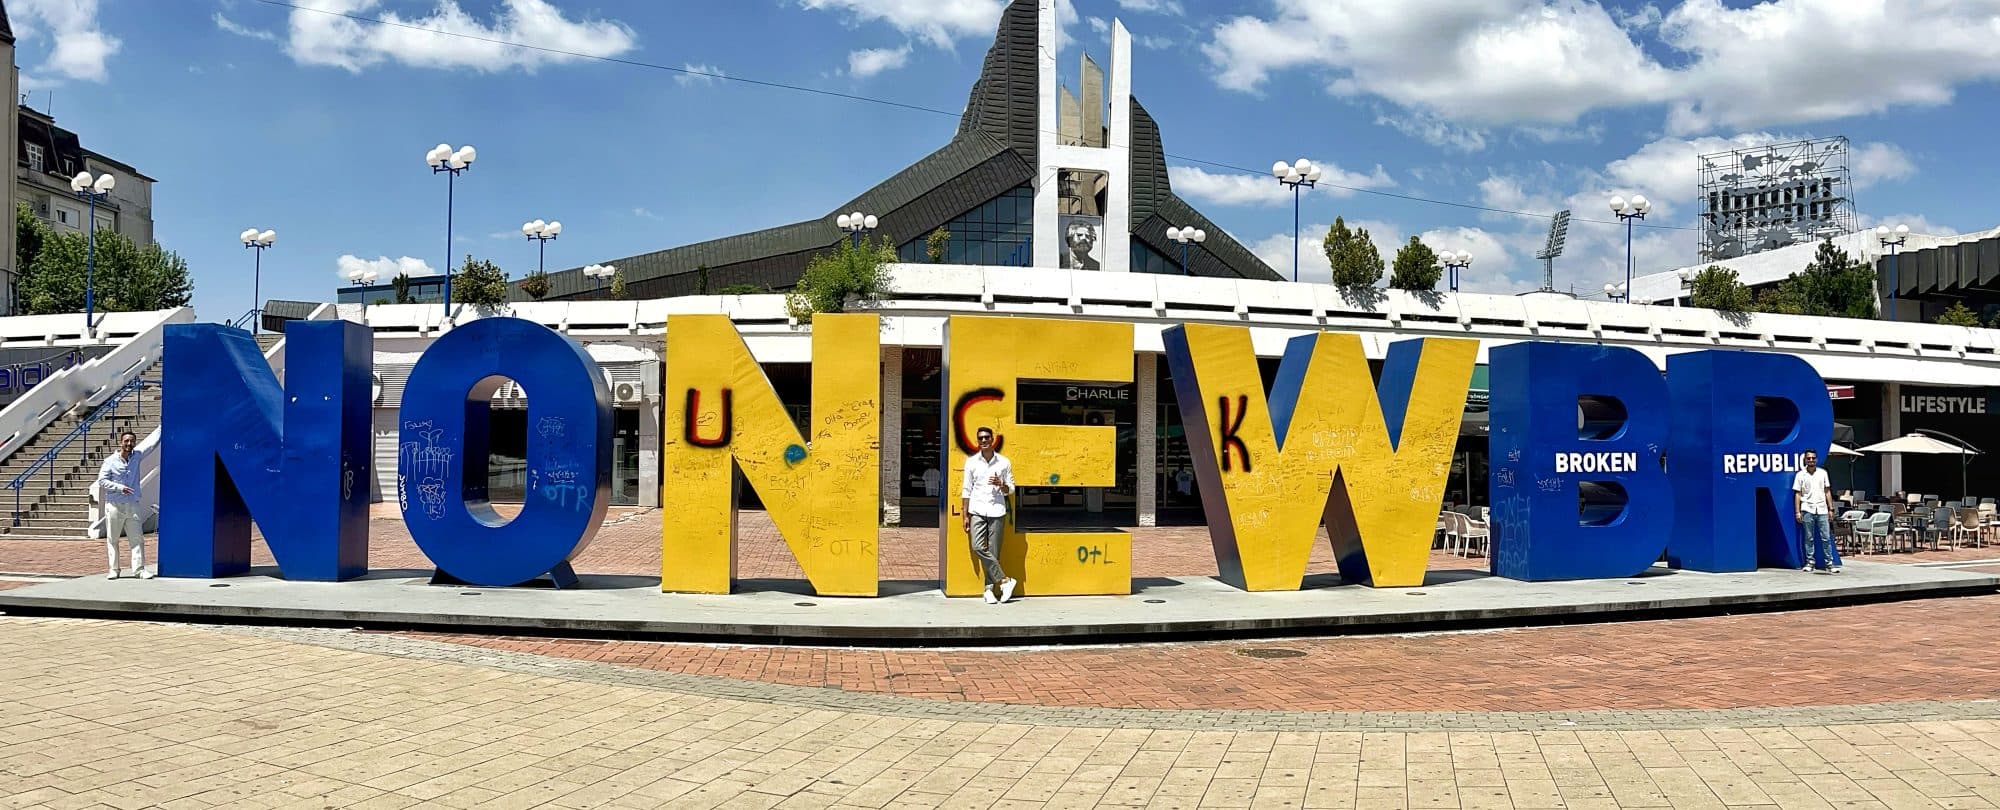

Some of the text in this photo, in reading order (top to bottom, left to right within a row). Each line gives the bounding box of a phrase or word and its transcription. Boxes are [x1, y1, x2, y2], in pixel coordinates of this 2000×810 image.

[1066, 387, 1129, 400] CHARLIE
[1901, 395, 1986, 414] LIFESTYLE
[1555, 452, 1637, 473] BROKEN
